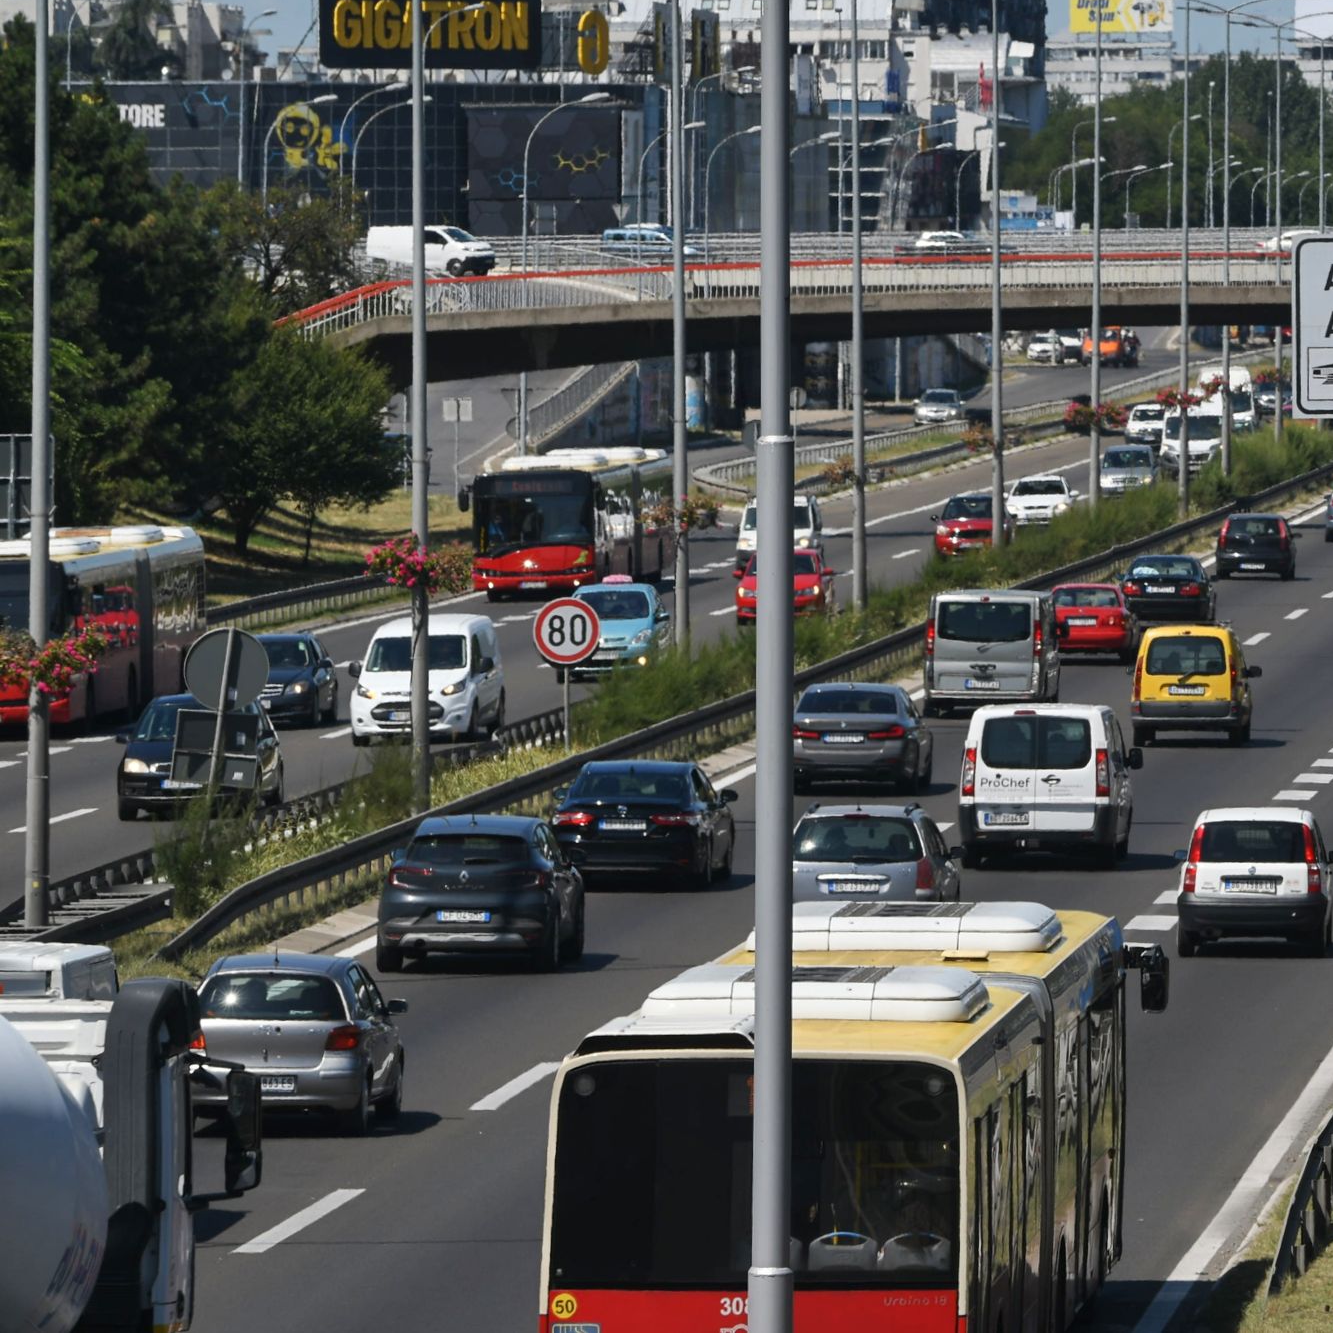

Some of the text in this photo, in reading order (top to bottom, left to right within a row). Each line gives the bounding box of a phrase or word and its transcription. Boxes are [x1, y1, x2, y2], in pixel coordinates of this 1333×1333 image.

[117, 104, 166, 128] TORE
[548, 613, 587, 647] 80
[554, 1297, 575, 1315] 50
[883, 1295, 948, 1306] Urbino 18
